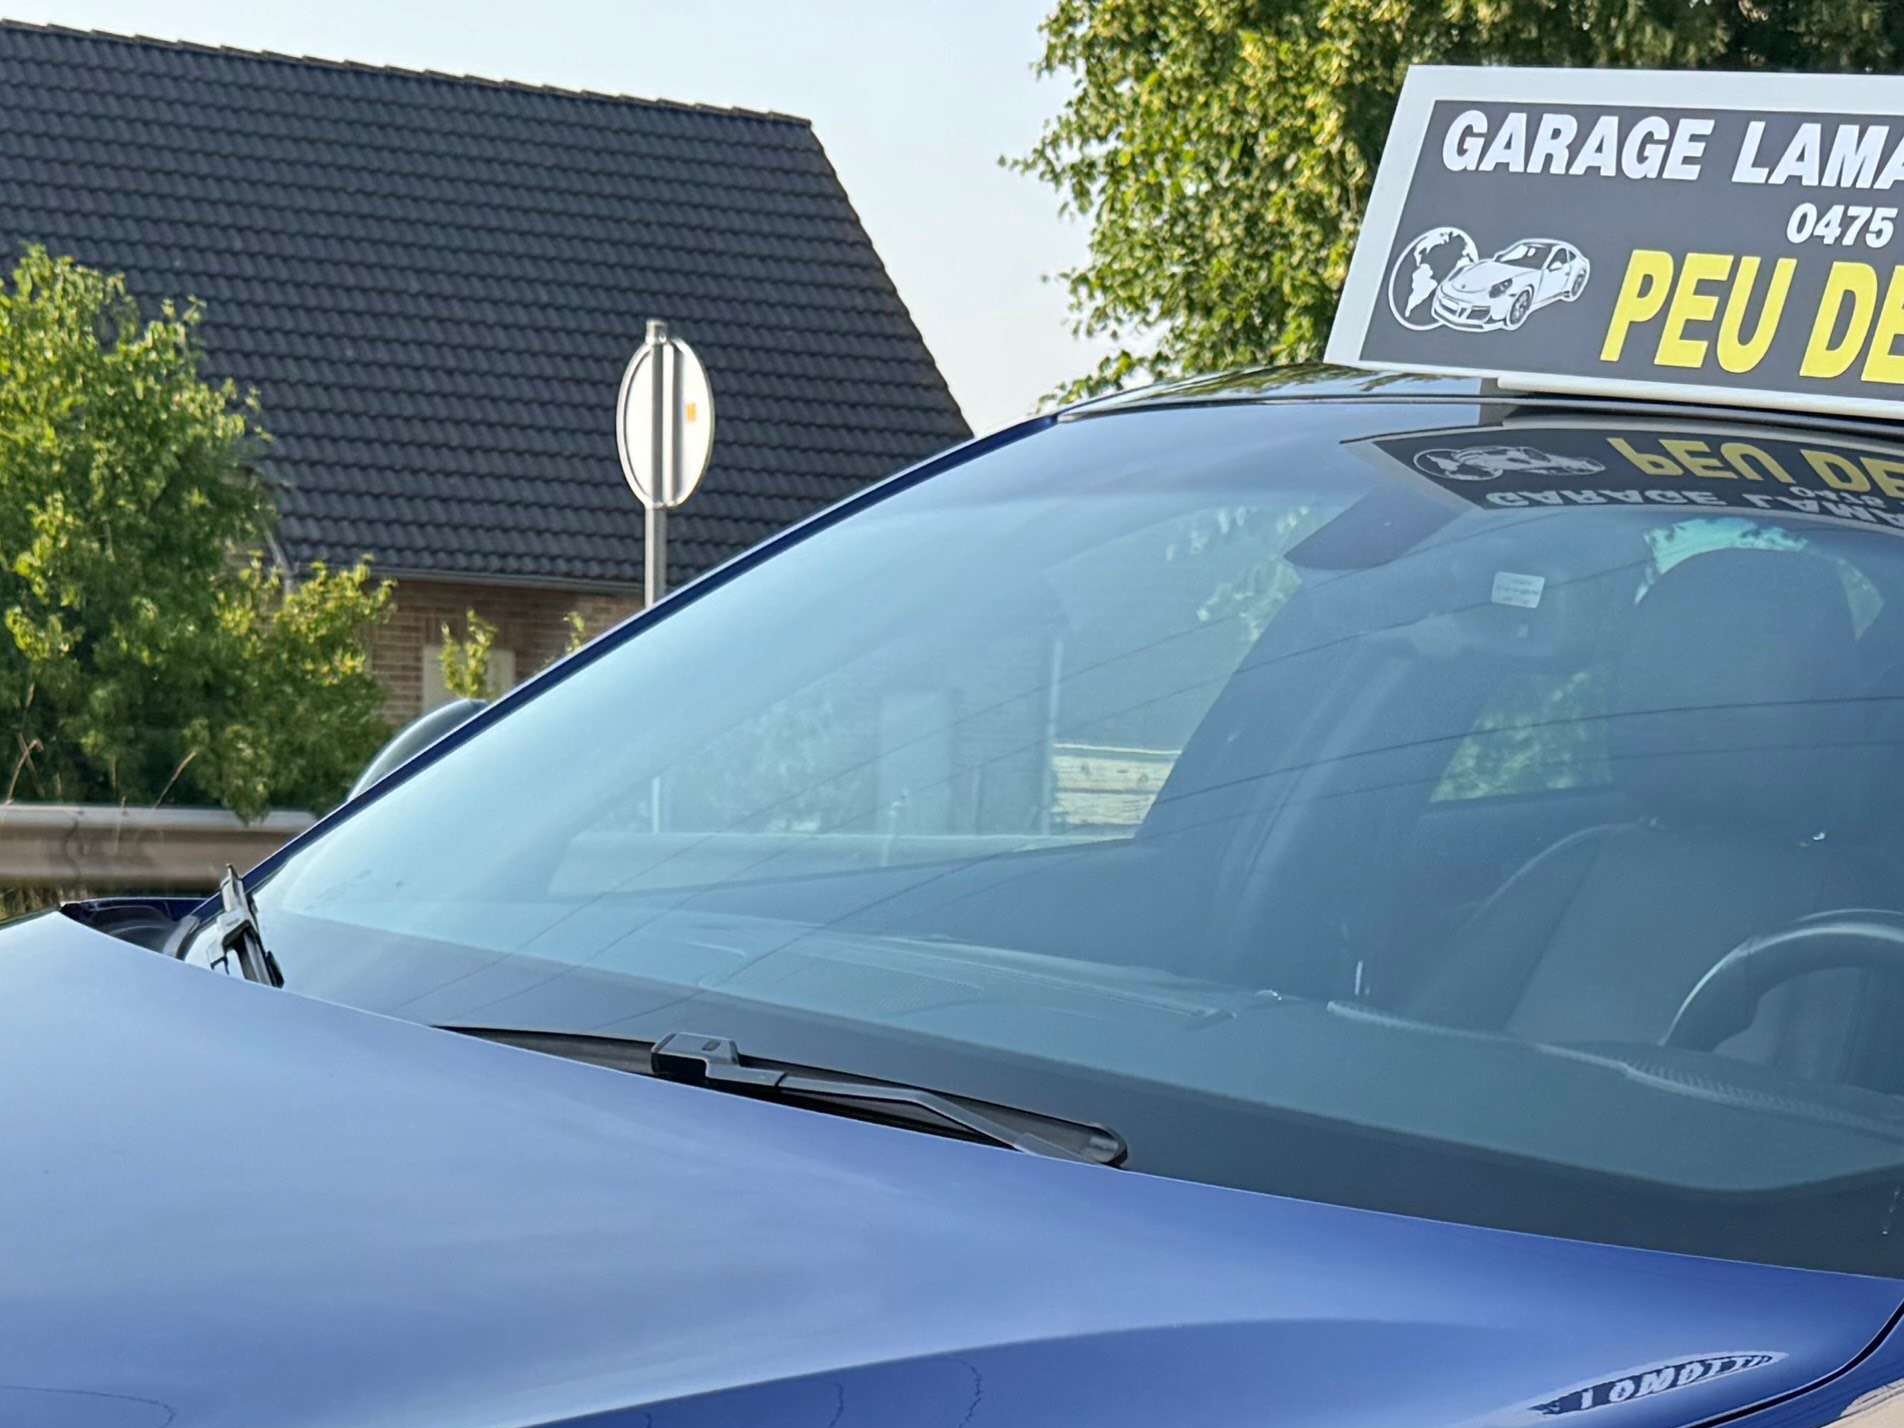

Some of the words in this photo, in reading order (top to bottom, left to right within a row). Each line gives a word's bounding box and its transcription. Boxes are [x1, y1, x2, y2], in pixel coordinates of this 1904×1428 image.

[1442, 109, 1716, 181] GARAGE
[1785, 202, 1898, 249] 0475
[1599, 248, 1798, 374] PEU
